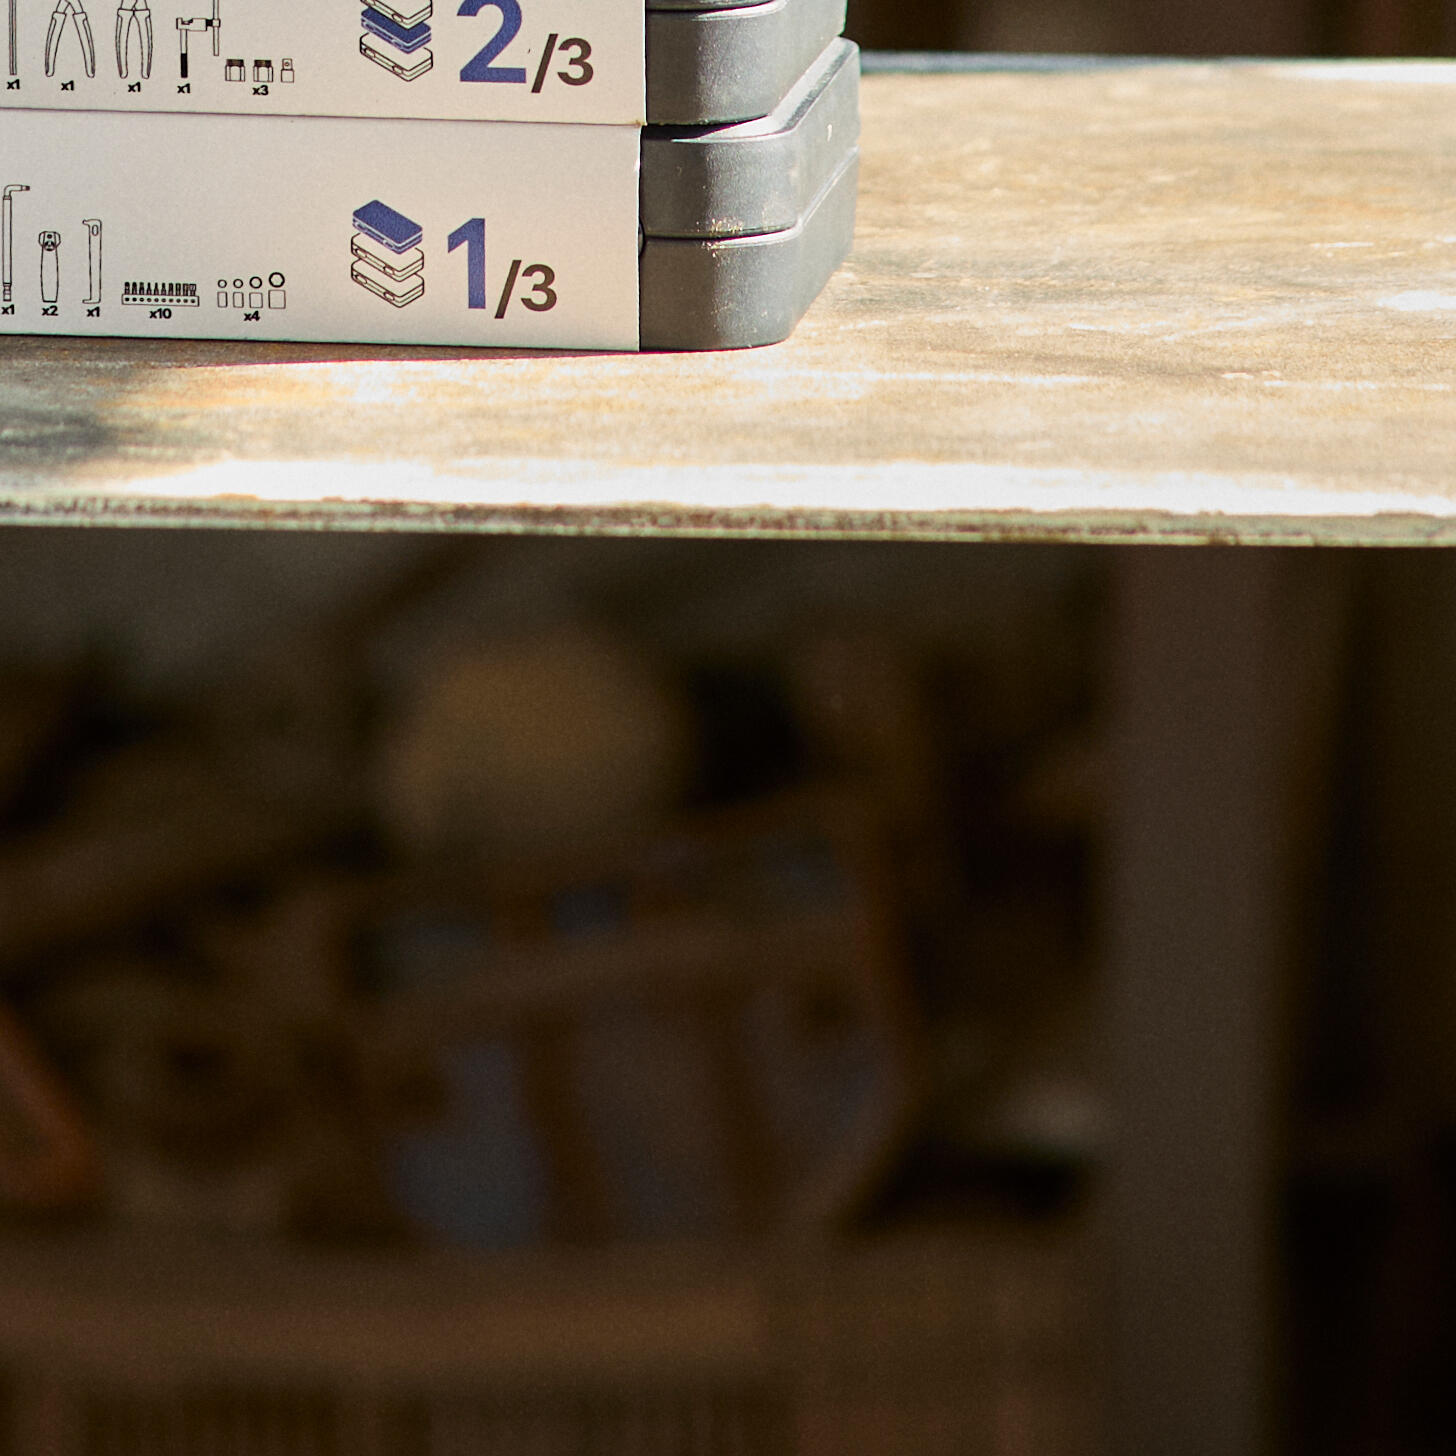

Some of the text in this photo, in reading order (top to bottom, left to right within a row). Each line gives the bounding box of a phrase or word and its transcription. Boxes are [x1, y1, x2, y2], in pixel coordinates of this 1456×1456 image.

[6, 78, 21, 90] x1
[60, 79, 75, 92] x1
[127, 81, 142, 93] x1
[177, 82, 191, 94] x1
[252, 84, 269, 96] x3
[1, 303, 15, 315] x1
[41, 304, 59, 317] x2
[86, 306, 101, 318] x1
[149, 307, 173, 320] x10
[243, 310, 261, 322] x4
